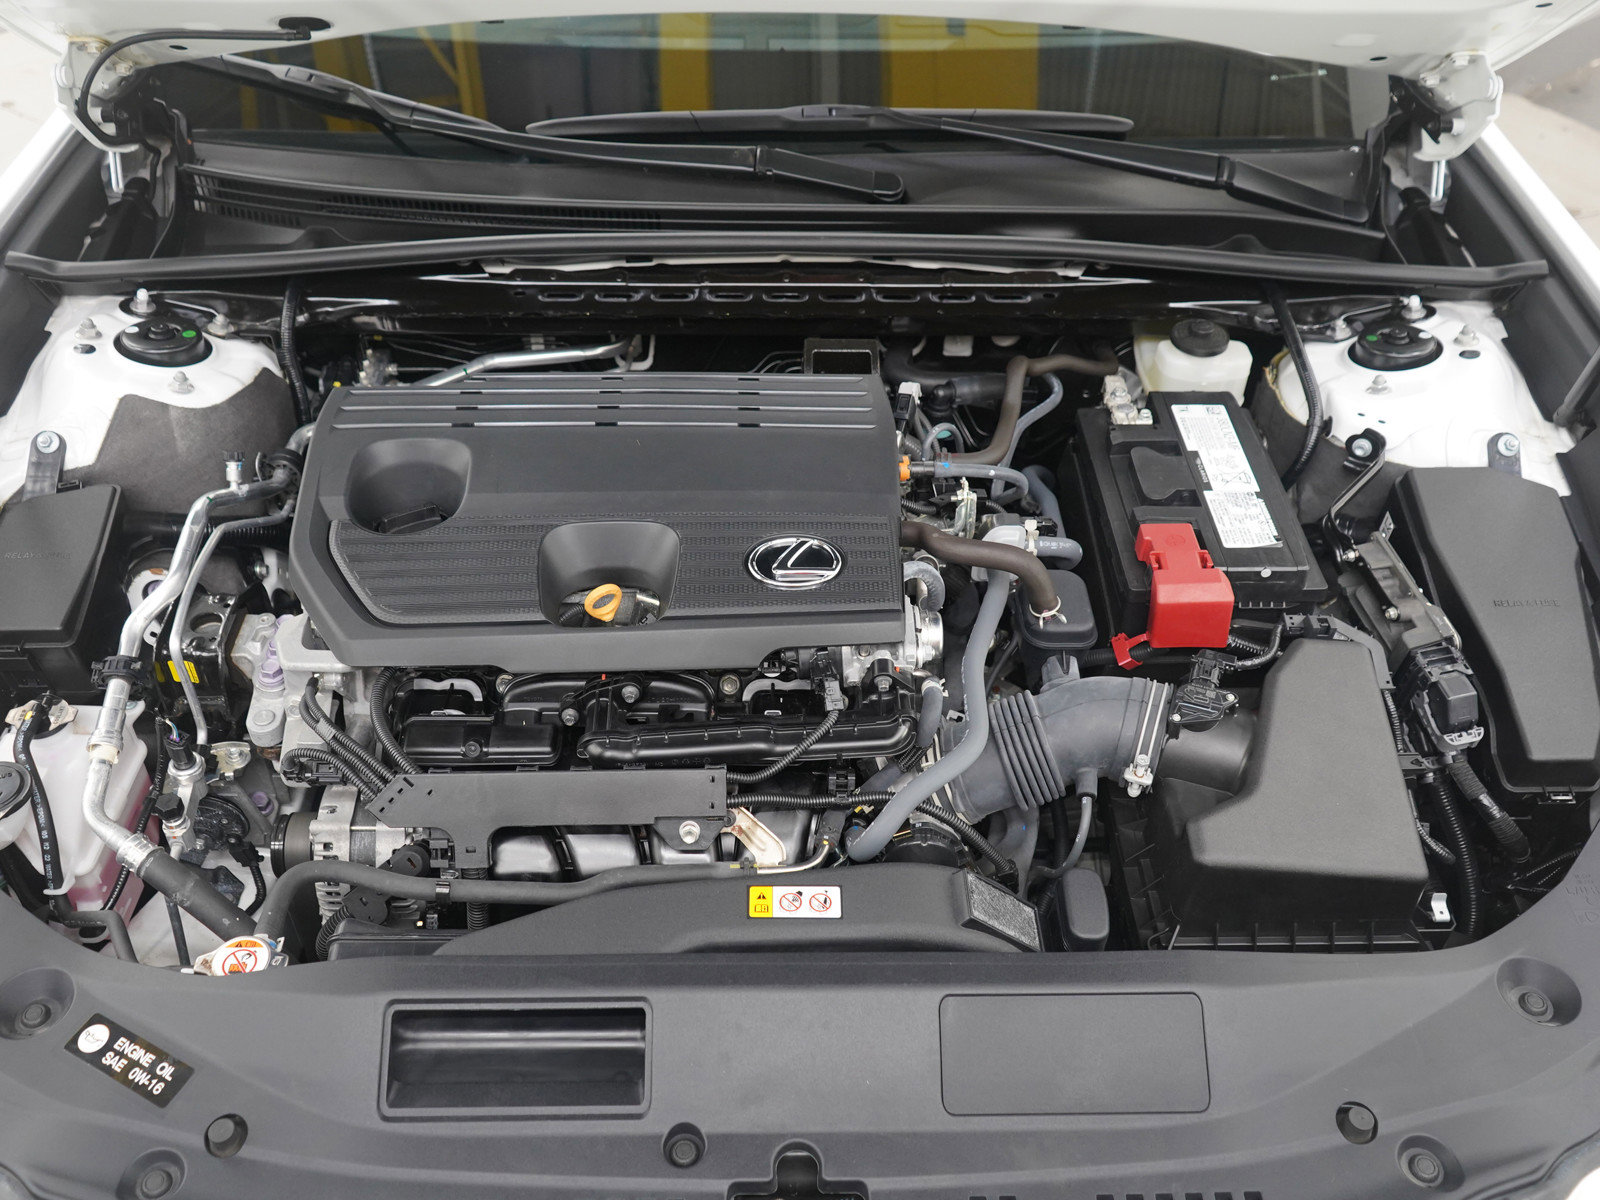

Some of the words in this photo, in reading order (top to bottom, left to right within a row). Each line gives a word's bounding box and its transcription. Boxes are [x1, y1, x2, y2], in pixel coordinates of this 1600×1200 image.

[101, 1051, 128, 1073] SAE
[128, 1067, 165, 1095] 0W-16
[113, 1037, 156, 1067] ENGINE
[155, 1062, 175, 1081] OIL
